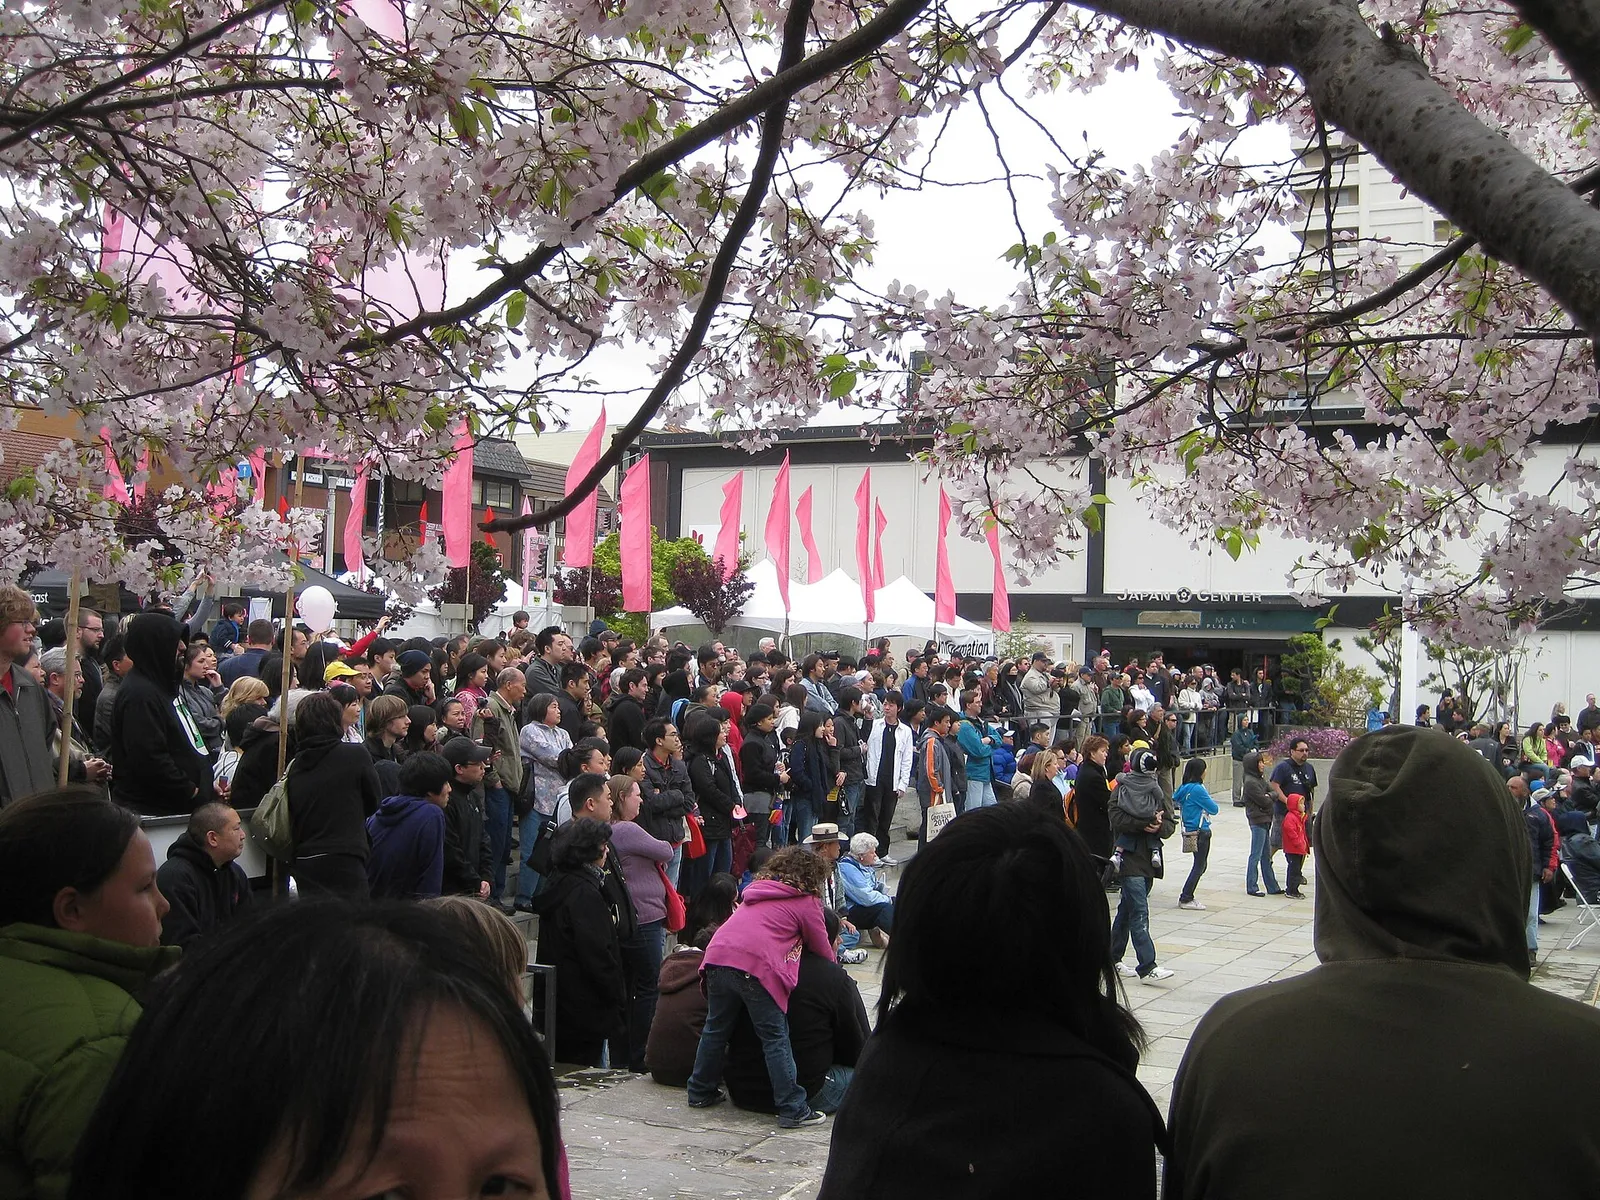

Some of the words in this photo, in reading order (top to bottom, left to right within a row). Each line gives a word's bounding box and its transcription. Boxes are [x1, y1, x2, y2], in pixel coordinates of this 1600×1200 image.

[1117, 588, 1171, 602] JAPAN
[1196, 588, 1262, 603] CENTER
[937, 638, 990, 656] Information
[934, 818, 950, 827] 2010
